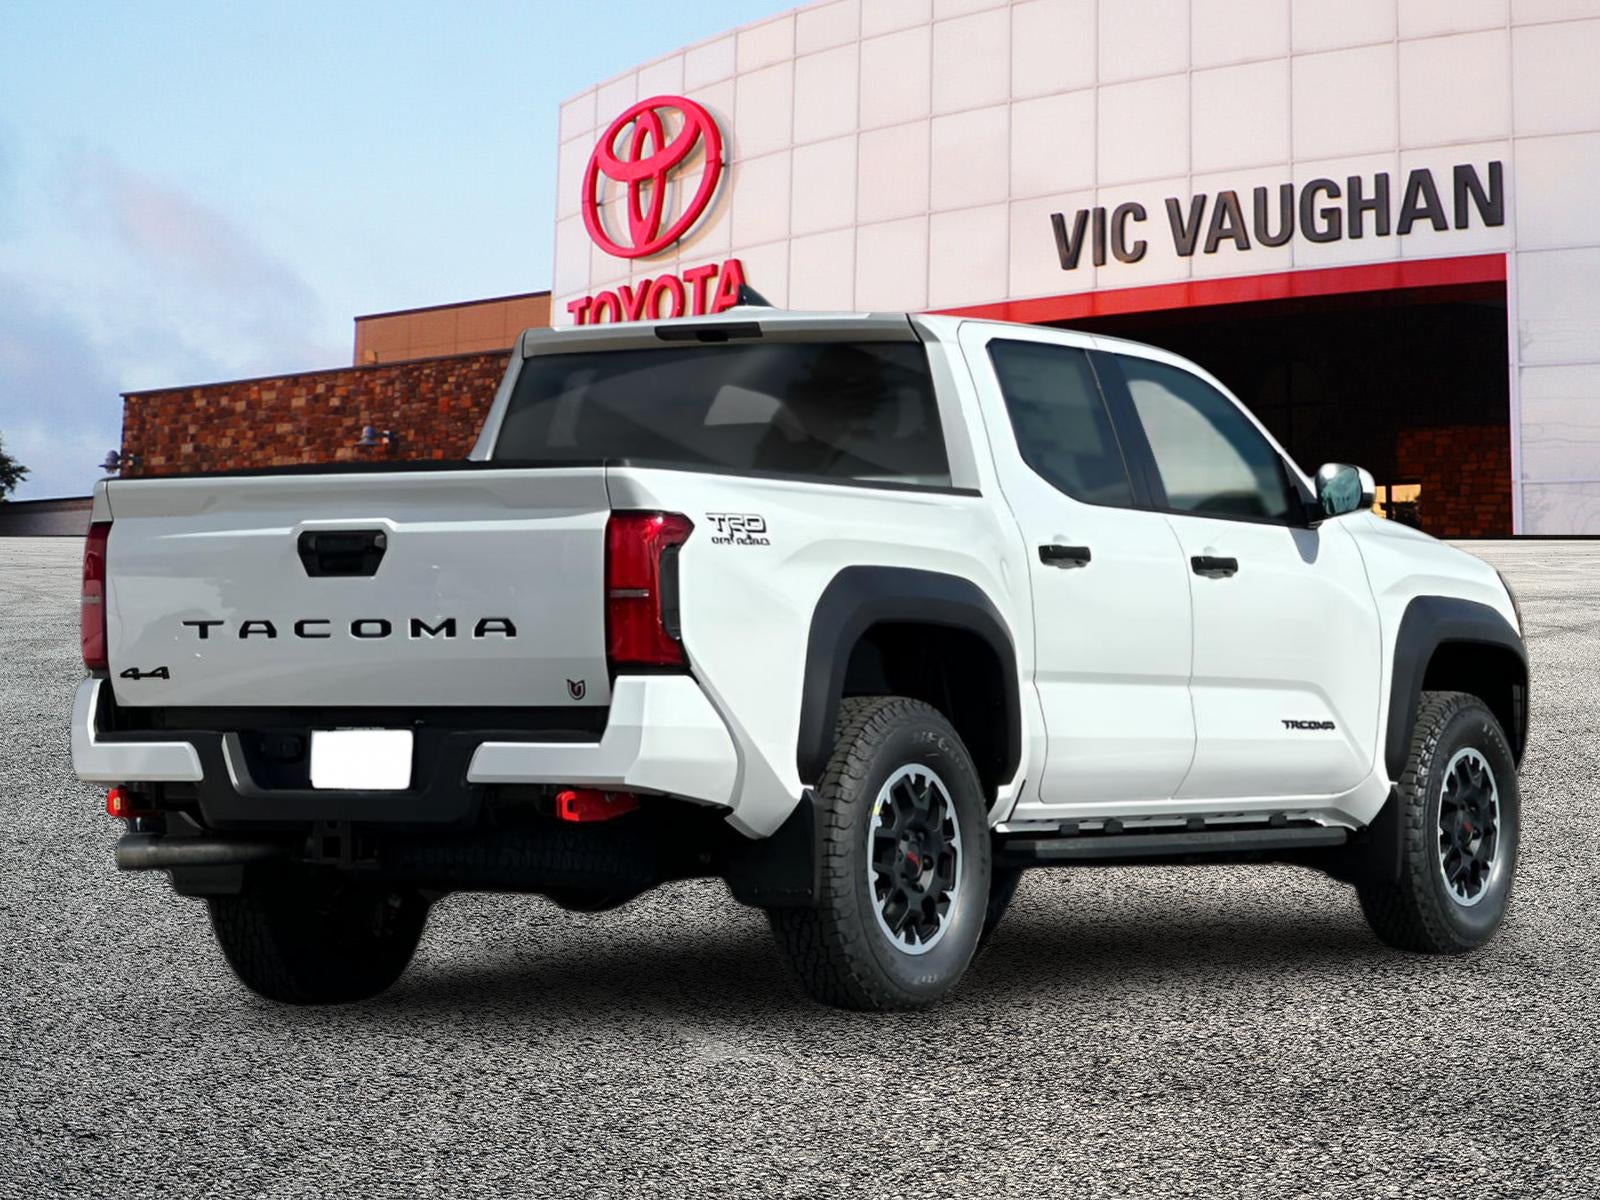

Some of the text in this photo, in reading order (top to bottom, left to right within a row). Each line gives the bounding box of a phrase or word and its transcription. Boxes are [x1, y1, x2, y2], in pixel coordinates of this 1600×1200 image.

[1050, 161, 1505, 271] VIC VAUGHAN
[567, 258, 746, 326] TOYOTA
[183, 617, 517, 640] TACOMA
[1282, 719, 1336, 730] TACOMA
